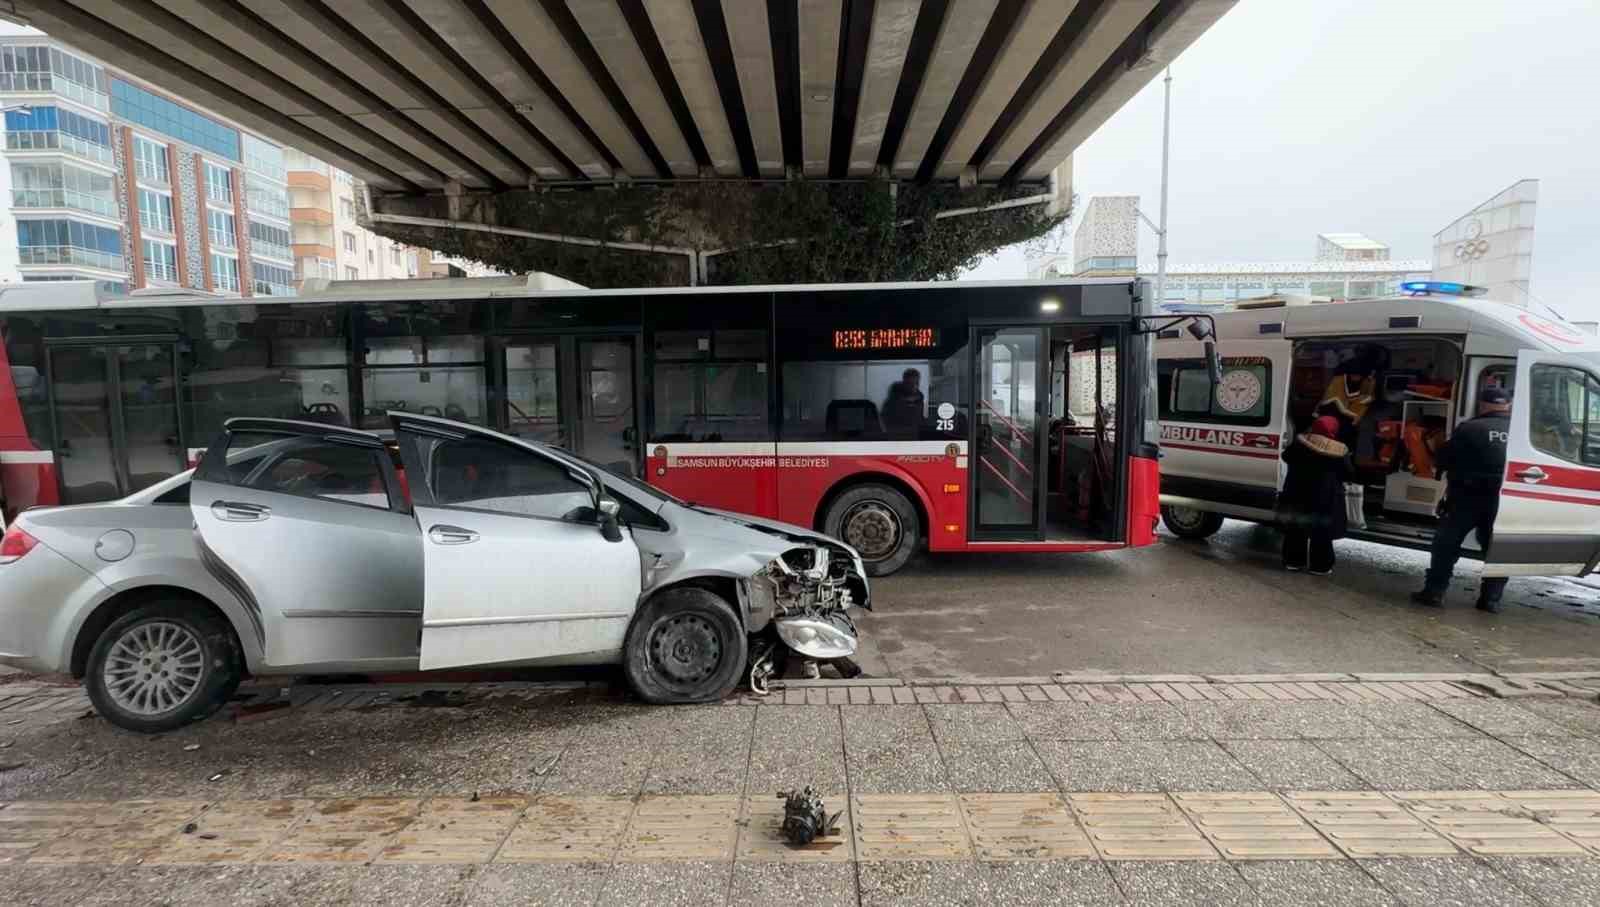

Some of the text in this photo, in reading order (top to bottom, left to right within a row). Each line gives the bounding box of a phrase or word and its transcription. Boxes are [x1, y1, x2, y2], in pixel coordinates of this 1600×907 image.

[936, 420, 954, 431] 215
[1159, 425, 1245, 446] MBULANS
[677, 457, 718, 468] SAMSUN
